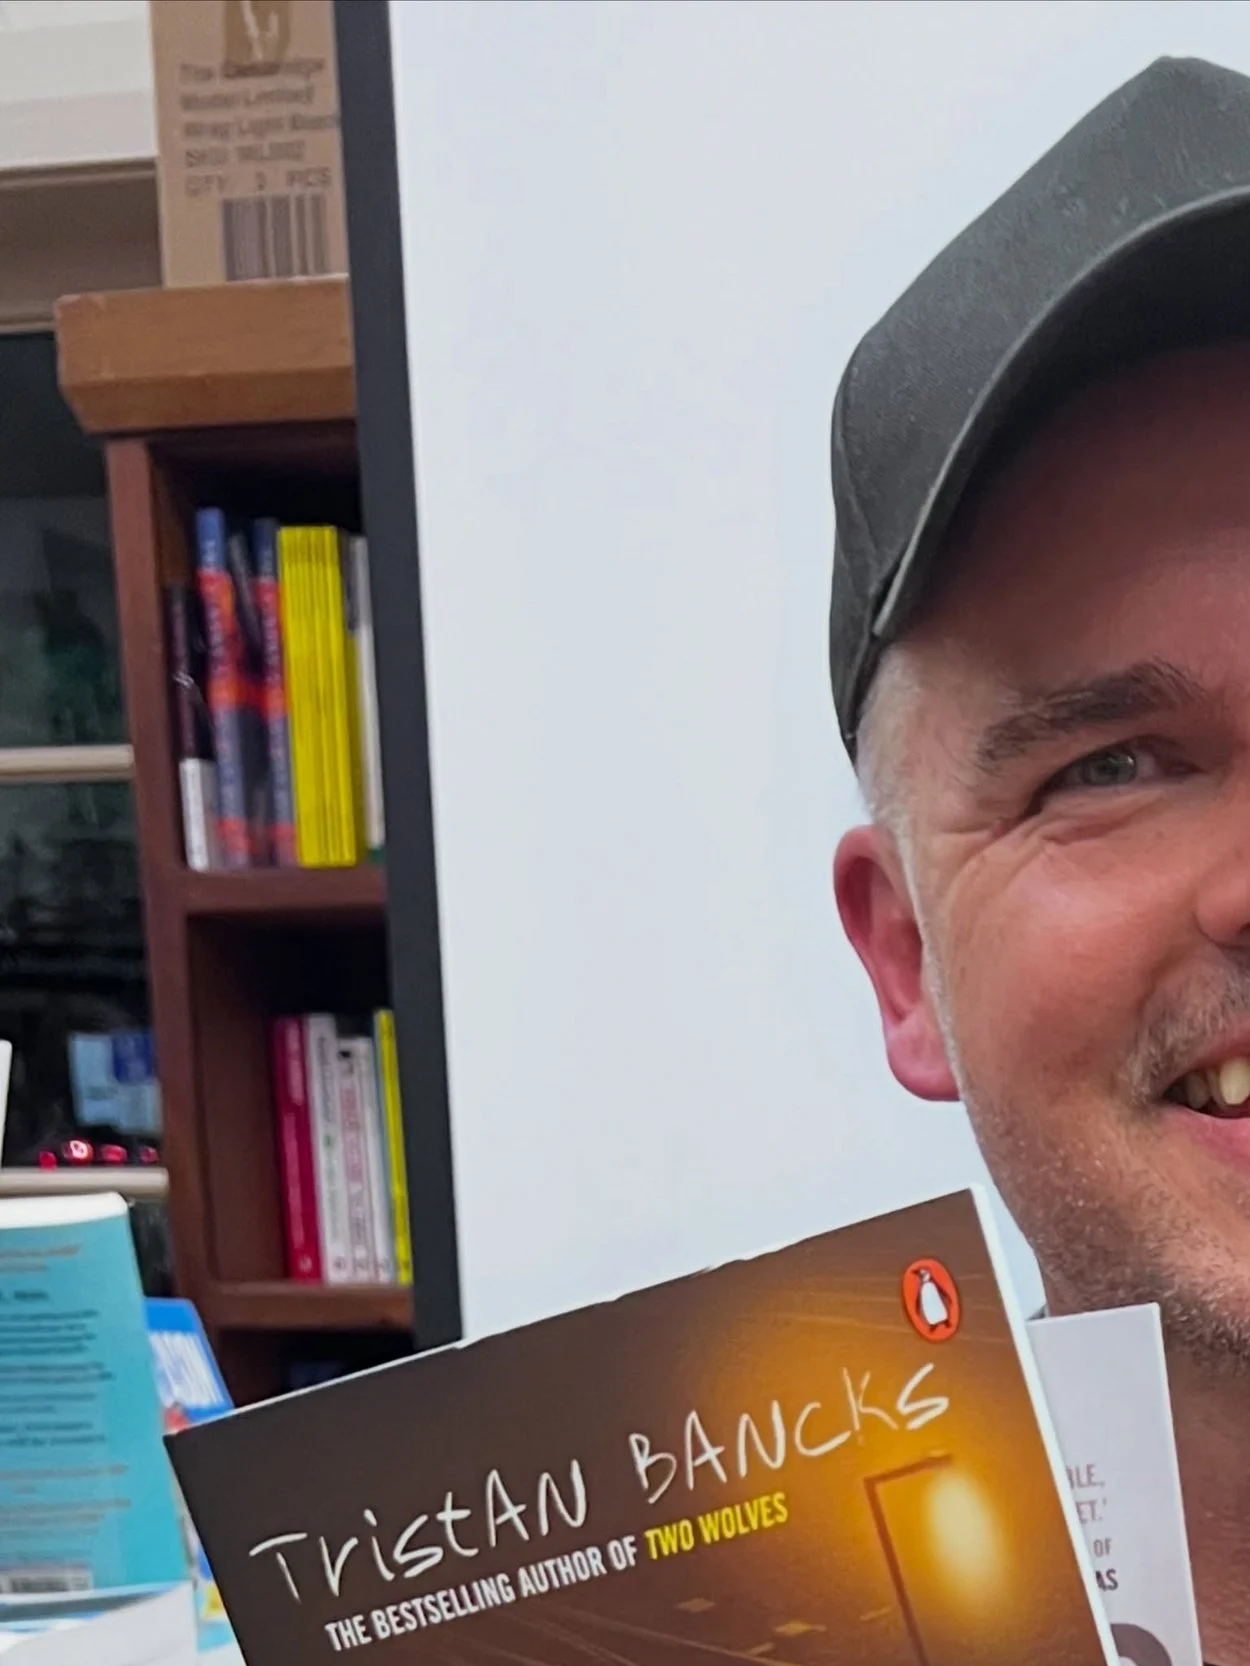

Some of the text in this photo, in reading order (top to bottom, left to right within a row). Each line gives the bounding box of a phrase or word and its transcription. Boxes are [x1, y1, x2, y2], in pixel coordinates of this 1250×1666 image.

[325, 1492, 789, 1651] THE BESTSELLING AUTHOR OF TWO WOLVES
[1093, 1538, 1113, 1558] OF
